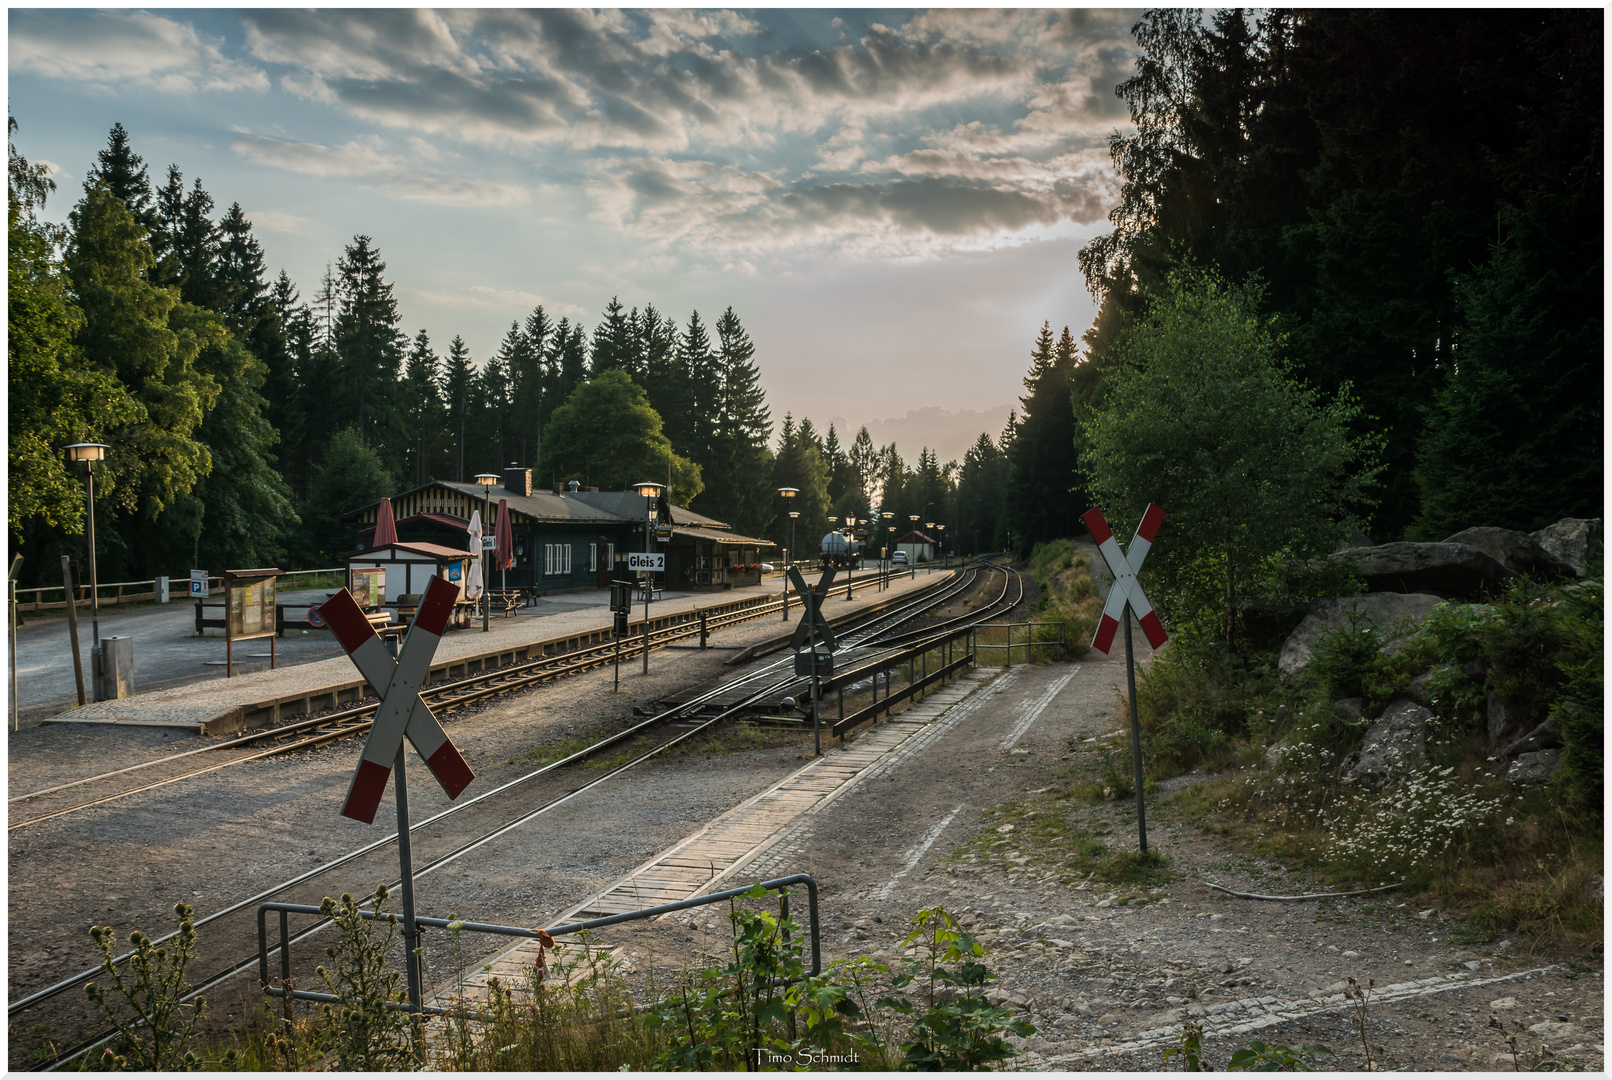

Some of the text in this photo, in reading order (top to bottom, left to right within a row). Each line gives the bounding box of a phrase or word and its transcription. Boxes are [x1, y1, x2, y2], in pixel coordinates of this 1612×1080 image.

[482, 538, 492, 547] Gleis
[630, 556, 664, 568] Gleis 2
[194, 583, 200, 592] P
